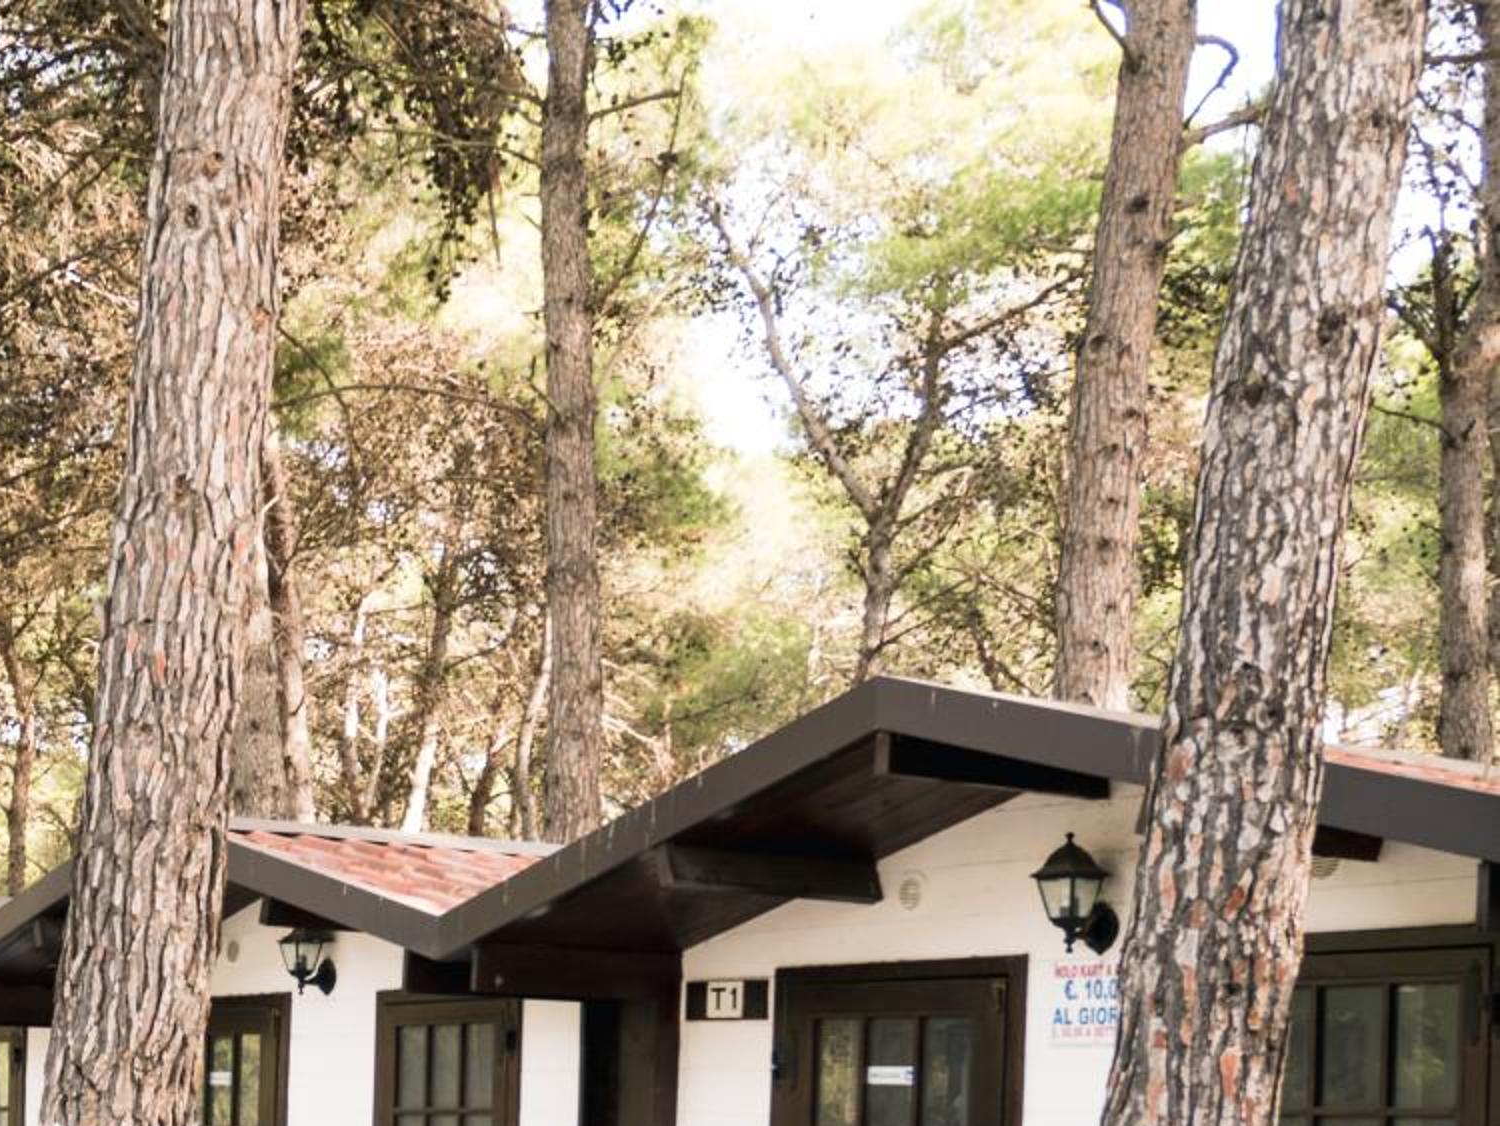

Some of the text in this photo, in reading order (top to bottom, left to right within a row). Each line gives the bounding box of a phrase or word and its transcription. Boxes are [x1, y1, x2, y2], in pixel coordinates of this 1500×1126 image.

[709, 986, 738, 1011] T1
[1053, 1007, 1118, 1025] AL GIOR
